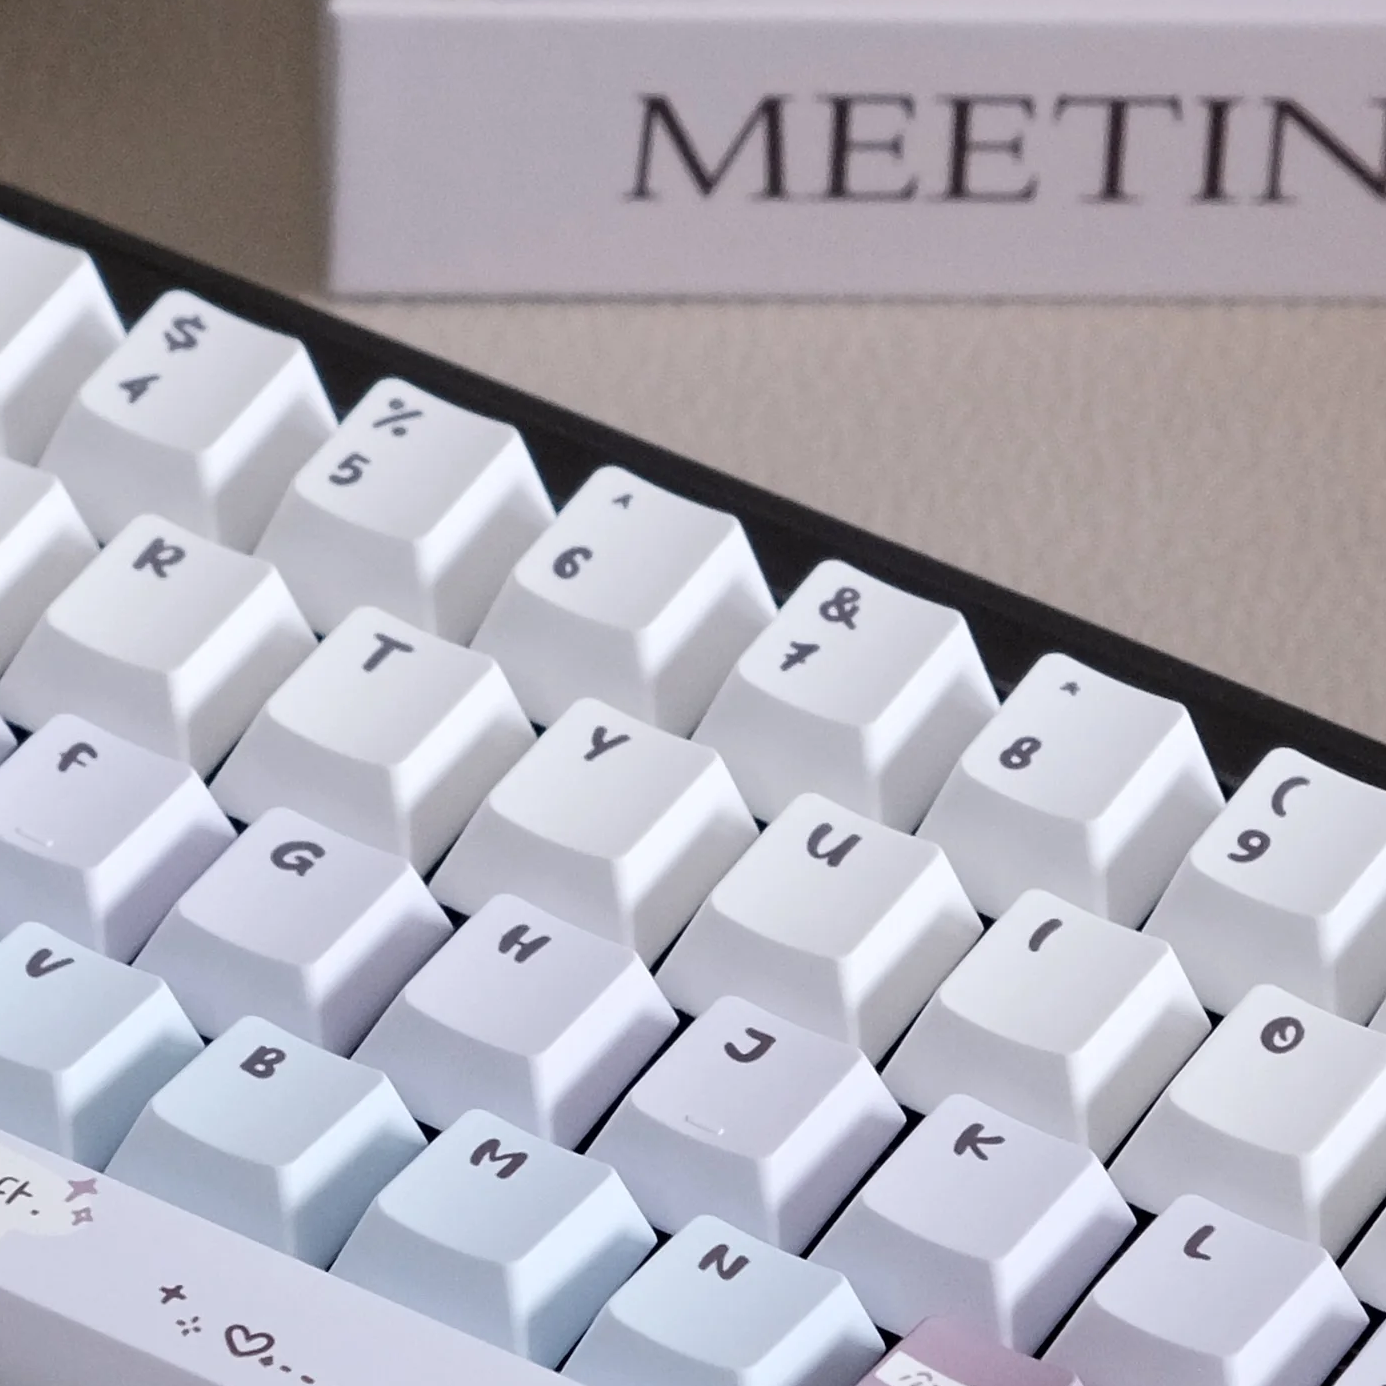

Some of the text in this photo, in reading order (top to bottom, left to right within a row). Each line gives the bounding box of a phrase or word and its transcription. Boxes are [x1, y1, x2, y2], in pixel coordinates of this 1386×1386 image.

[164, 315, 206, 352] $
[119, 375, 160, 403] 4
[373, 398, 423, 437] %
[329, 453, 370, 486] 5
[133, 538, 186, 578] R
[553, 547, 593, 579] 6
[819, 587, 861, 630] &
[363, 633, 414, 672] T
[780, 641, 820, 671] 7
[58, 742, 98, 772] F
[584, 726, 630, 761] Y
[999, 737, 1042, 770] 8
[1271, 777, 1310, 817] (
[270, 841, 325, 876] G
[807, 823, 862, 867] U
[1227, 830, 1270, 863] 9
[498, 924, 551, 963] H
[26, 948, 74, 978] V
[724, 1028, 776, 1063] J
[1260, 1017, 1305, 1054] O
[240, 1046, 286, 1079] B
[470, 1139, 528, 1179] M
[954, 1123, 1005, 1160] K
[1184, 1225, 1215, 1260] L
[698, 1244, 750, 1280] N
